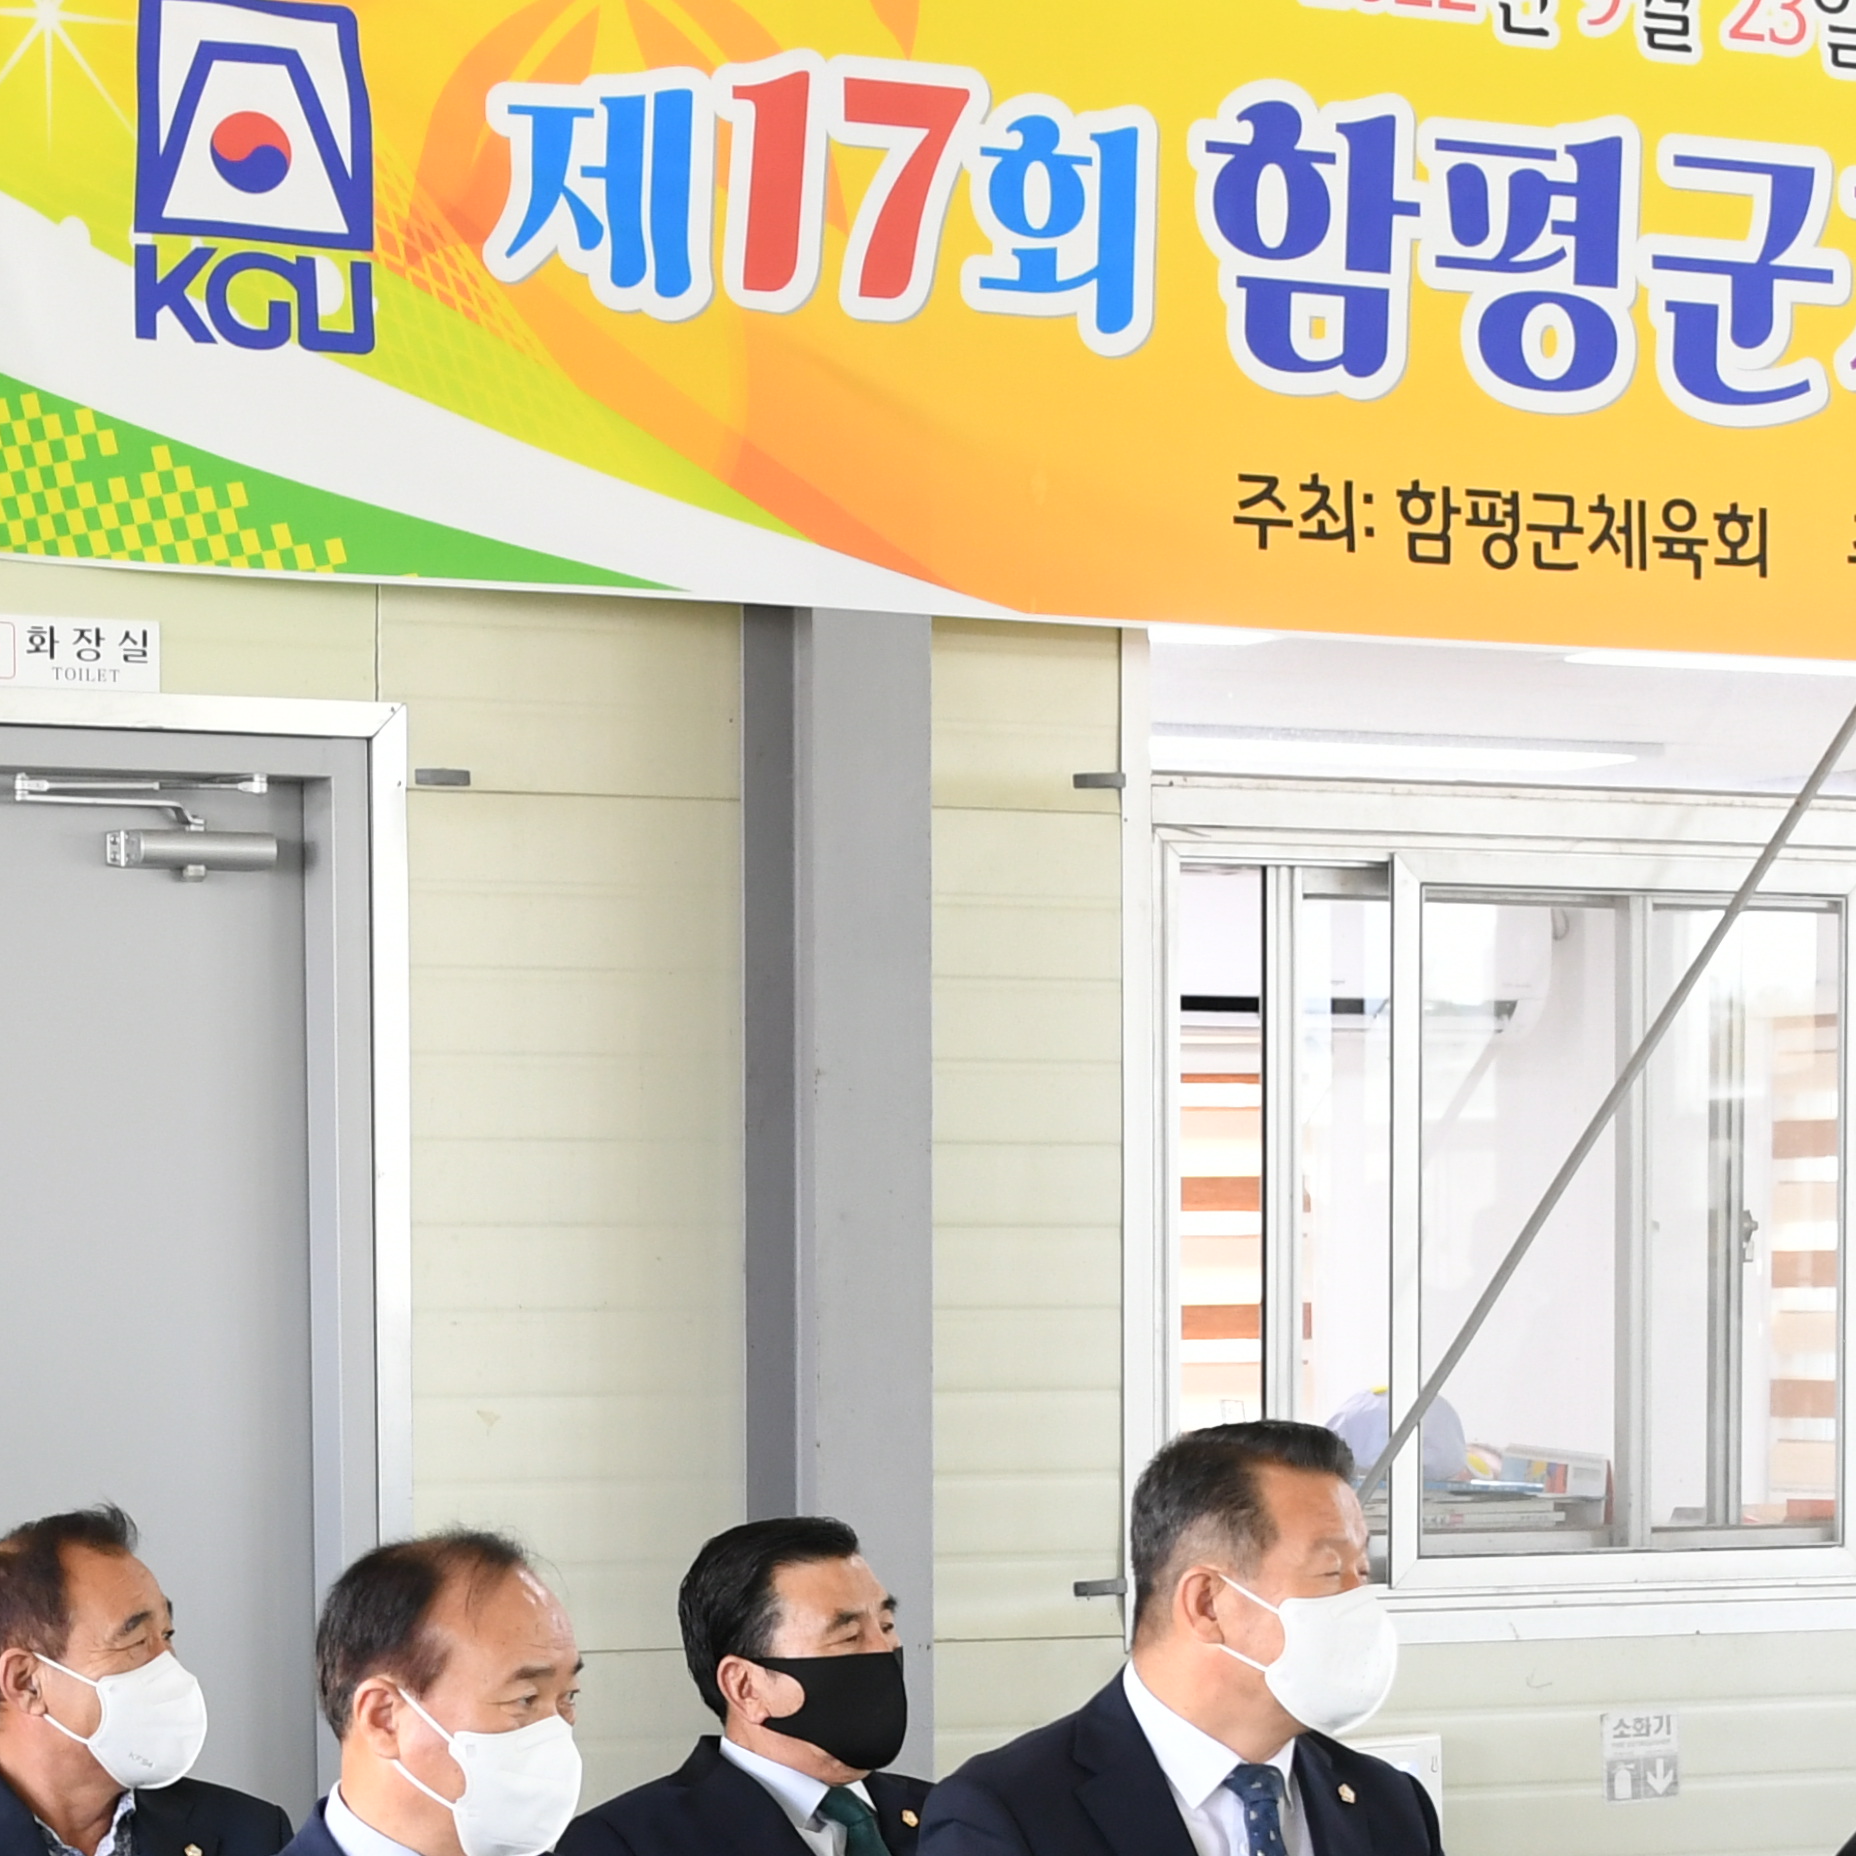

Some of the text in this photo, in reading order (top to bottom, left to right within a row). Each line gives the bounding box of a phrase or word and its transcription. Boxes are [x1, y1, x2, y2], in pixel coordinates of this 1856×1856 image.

[505, 69, 1139, 336] 제17회
[1232, 472, 1768, 580] 주최: 함평군체육회
[51, 666, 120, 683] TOILET
[1612, 1714, 1671, 1739] 소화기
